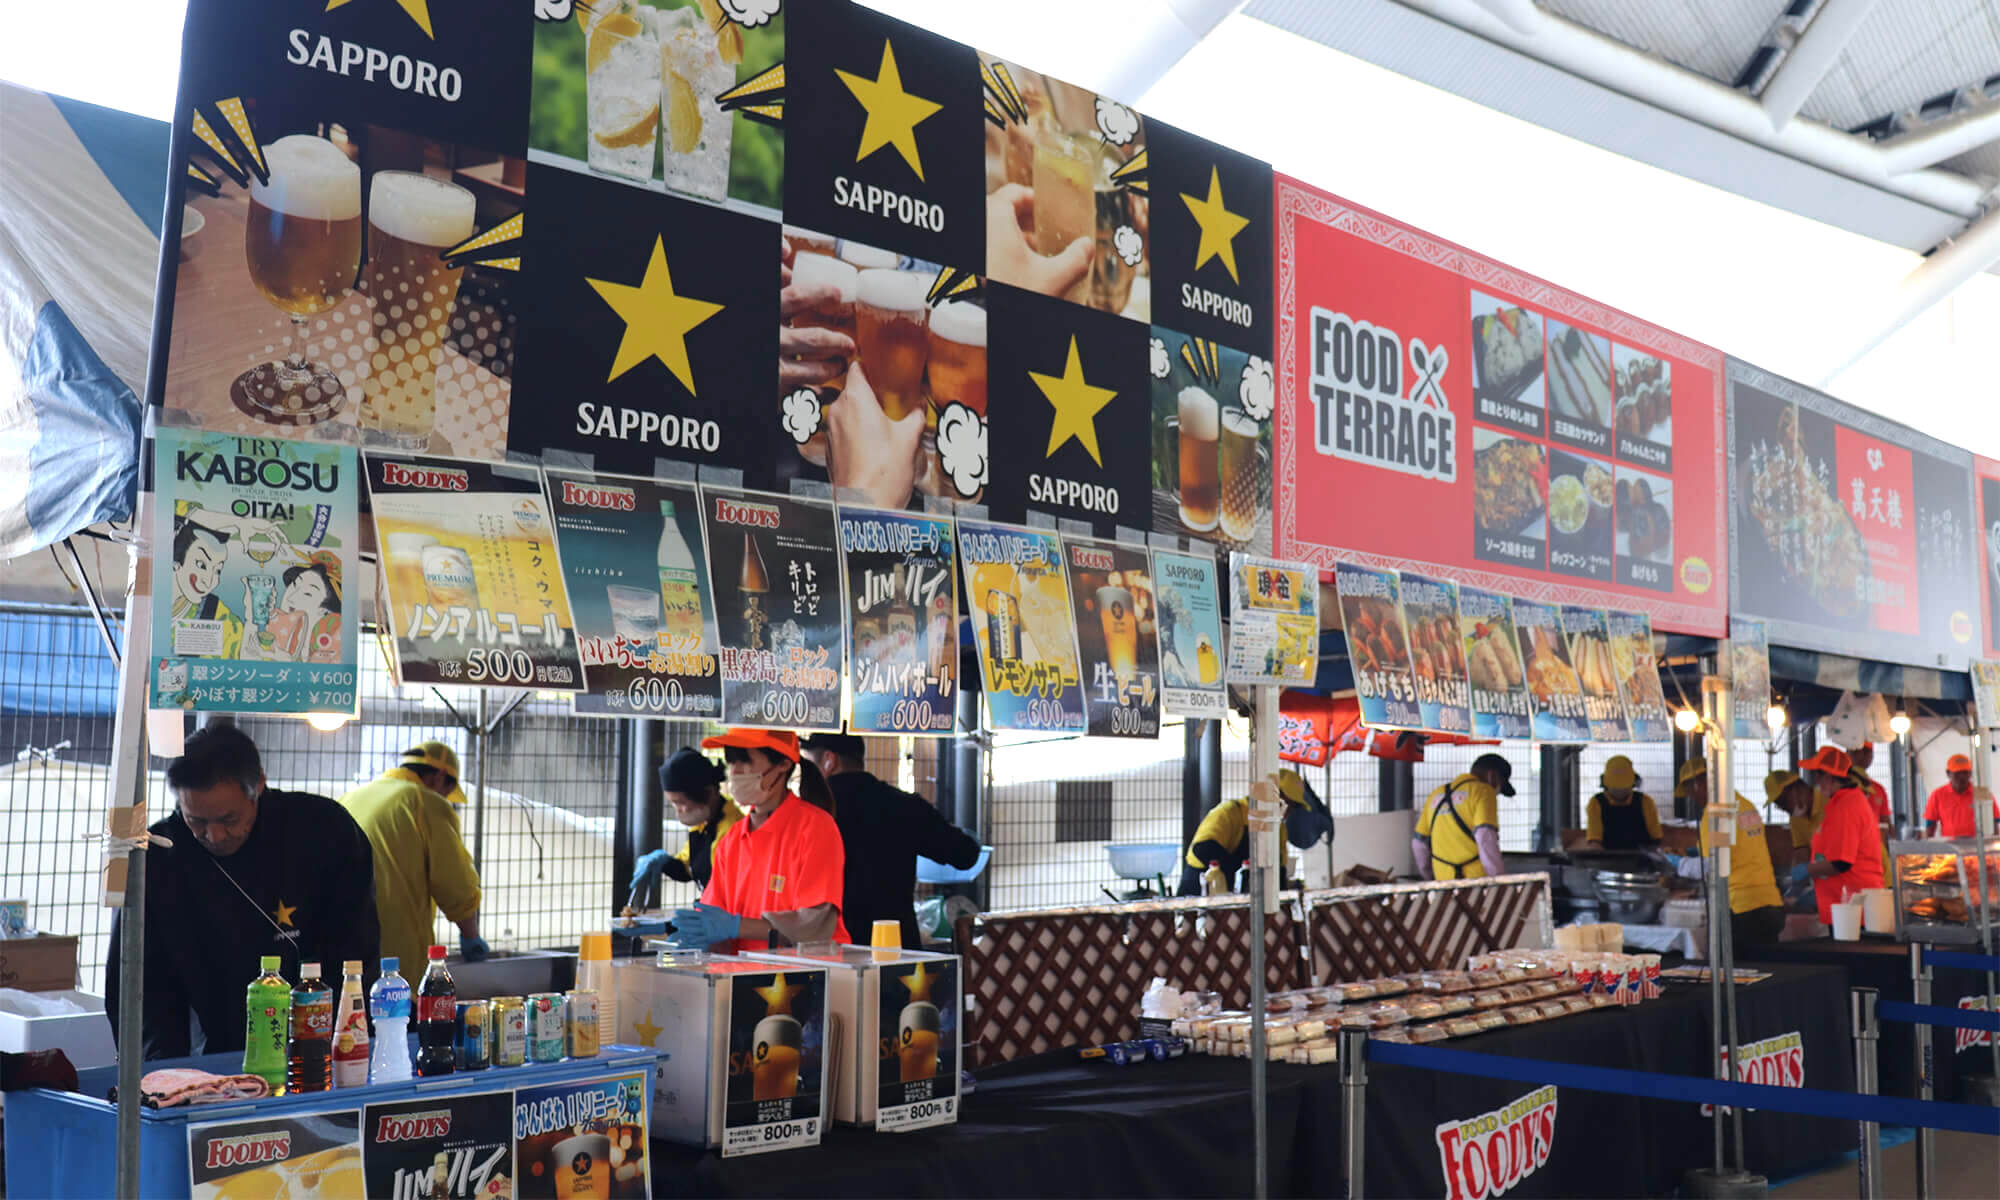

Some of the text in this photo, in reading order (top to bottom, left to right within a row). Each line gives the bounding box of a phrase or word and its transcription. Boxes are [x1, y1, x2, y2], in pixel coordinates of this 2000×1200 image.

[287, 28, 463, 102] SAPPORO
[834, 175, 944, 233] SAPPORO
[1182, 283, 1252, 328] SAPPORO
[1314, 314, 1399, 396] FOOD
[231, 436, 285, 458] TRY
[576, 402, 720, 453] SAPPORO
[1313, 382, 1453, 476] TERRACE
[177, 449, 339, 493] KABOSU
[230, 498, 295, 521] OITA!
[1029, 473, 1119, 514] SAPPORO
[1165, 563, 1206, 583] SAPPORO
[407, 604, 566, 649] ノンアルコール
[657, 631, 702, 651] ロック
[789, 645, 829, 666] ロック
[628, 676, 684, 712] 600
[856, 656, 953, 699] ジムハイボール
[989, 659, 1079, 700] レモンサワー
[1094, 661, 1156, 708] 生ビール
[1359, 668, 1416, 704] あげもち
[761, 690, 809, 723] 600
[1111, 706, 1142, 735] 800
[1460, 1115, 1499, 1141] FOOD
